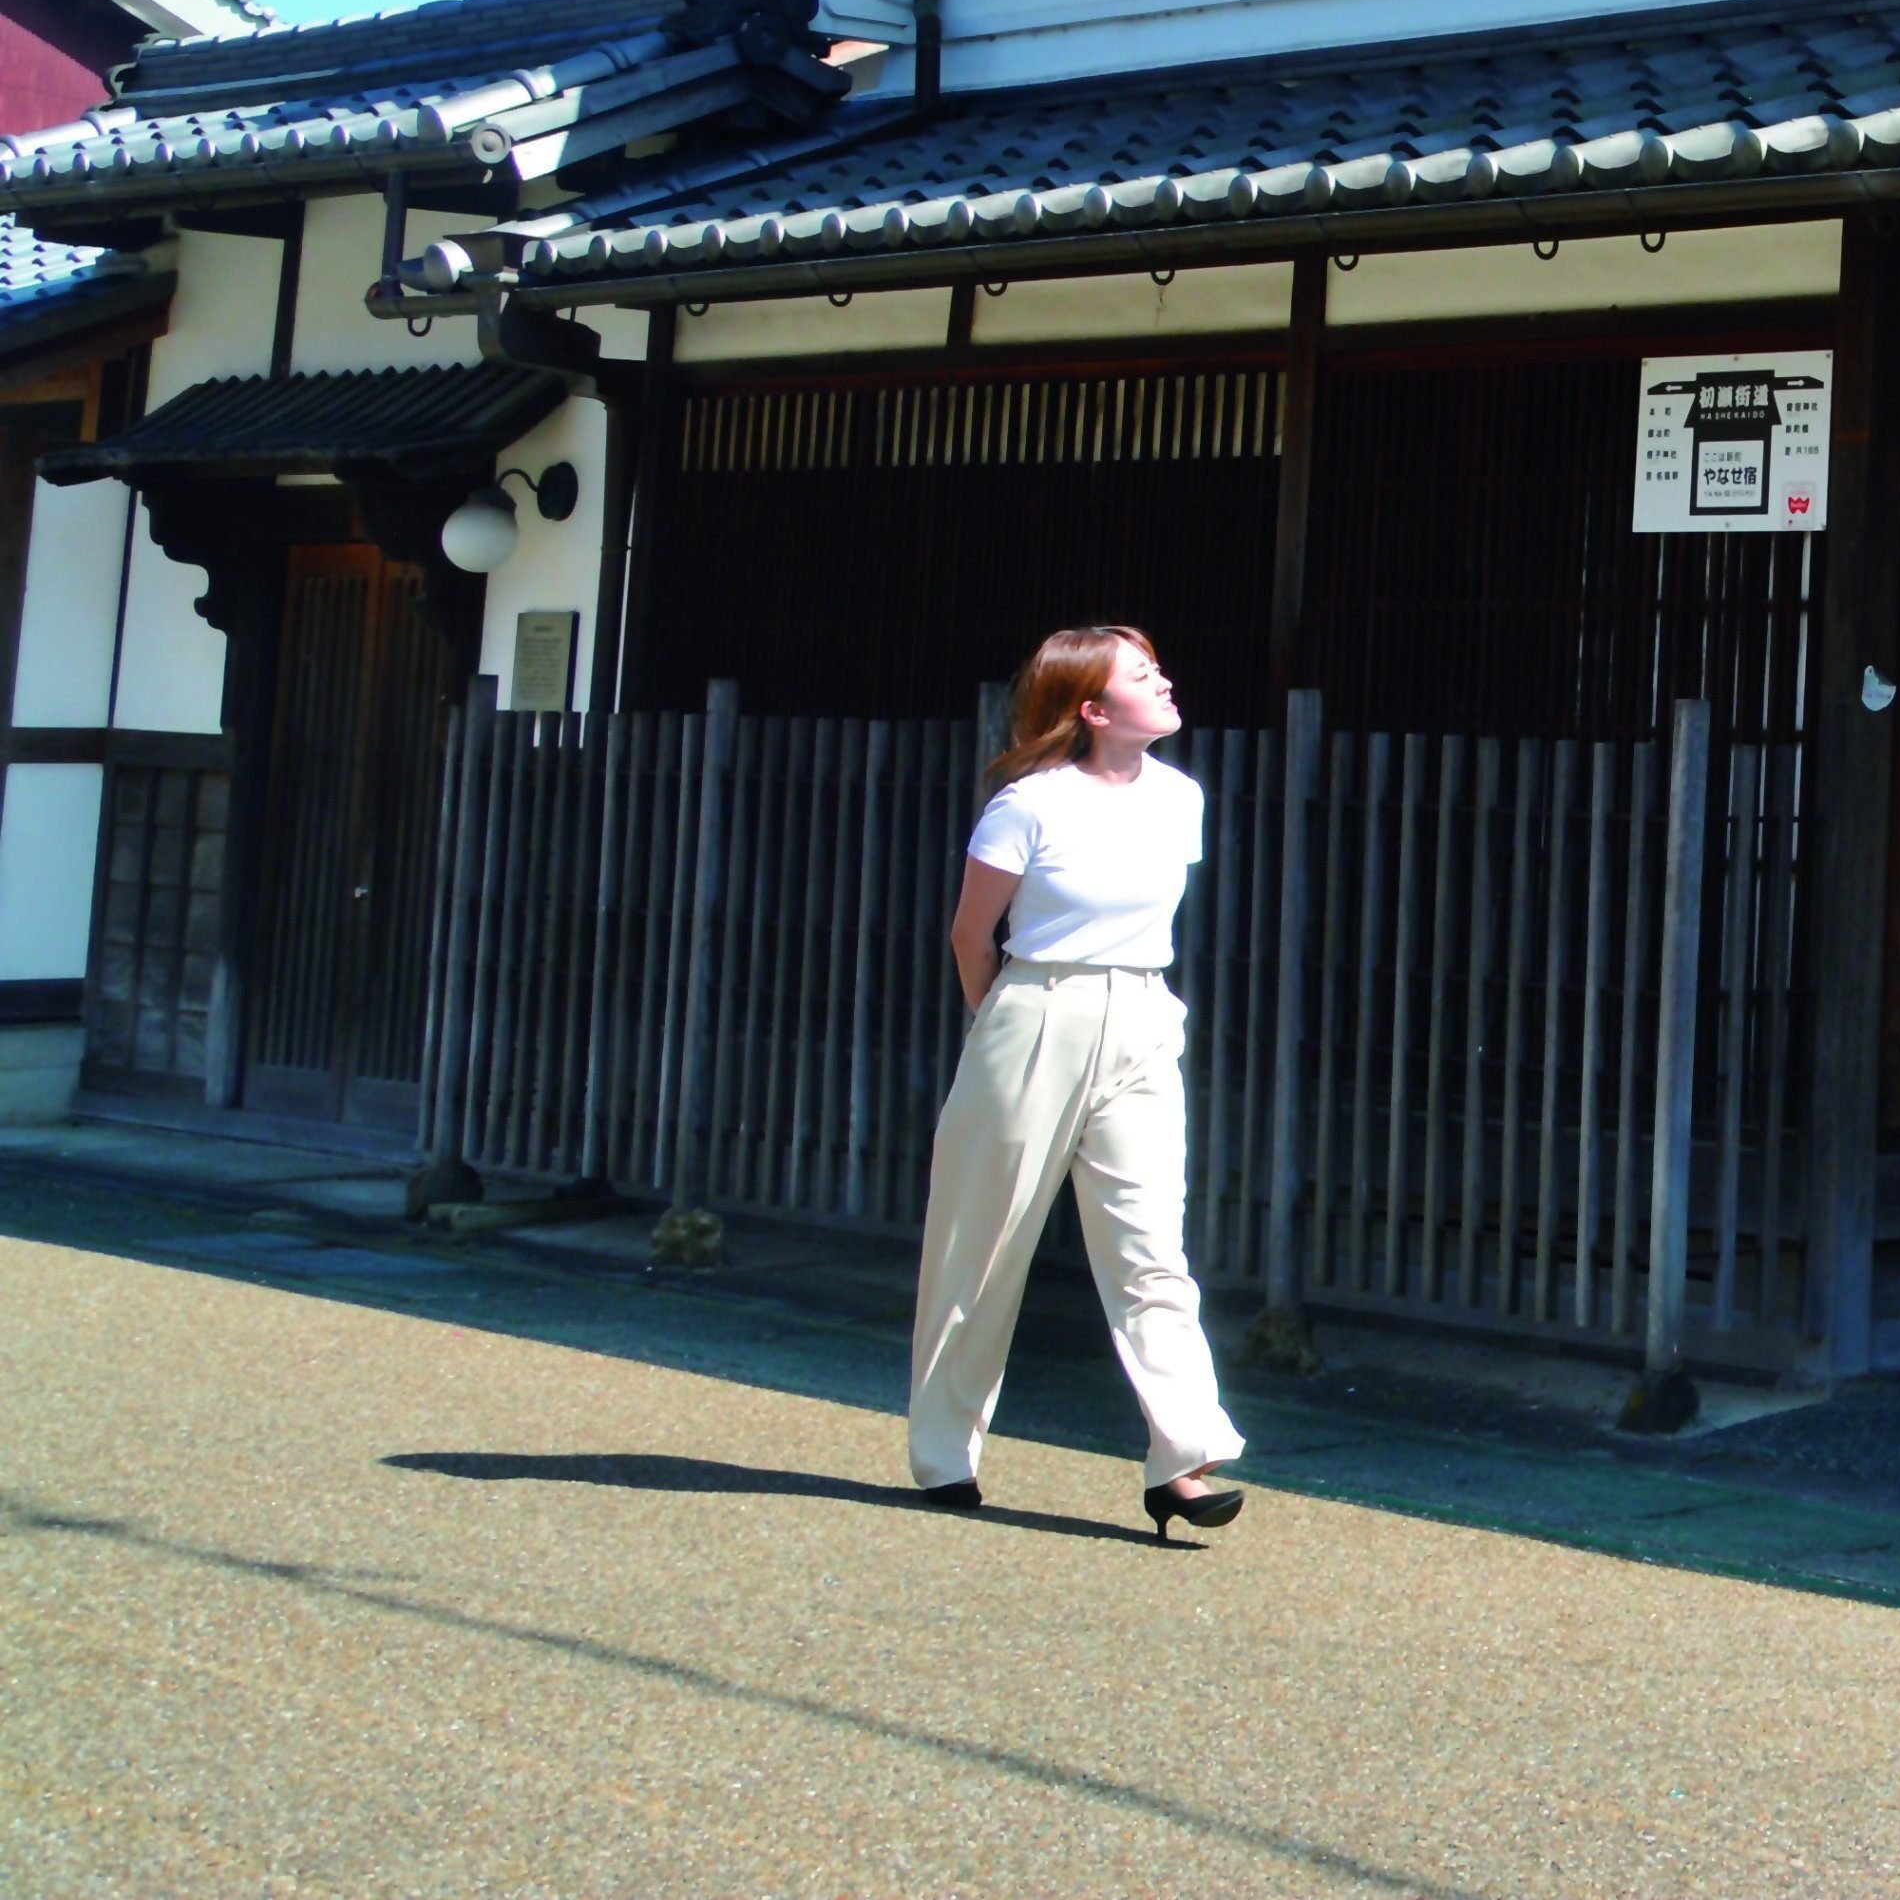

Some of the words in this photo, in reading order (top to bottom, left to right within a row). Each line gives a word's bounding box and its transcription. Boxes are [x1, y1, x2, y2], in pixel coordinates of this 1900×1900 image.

[1699, 384, 1769, 409] 初瀬街道
[1703, 466, 1757, 486] やなせ宿
